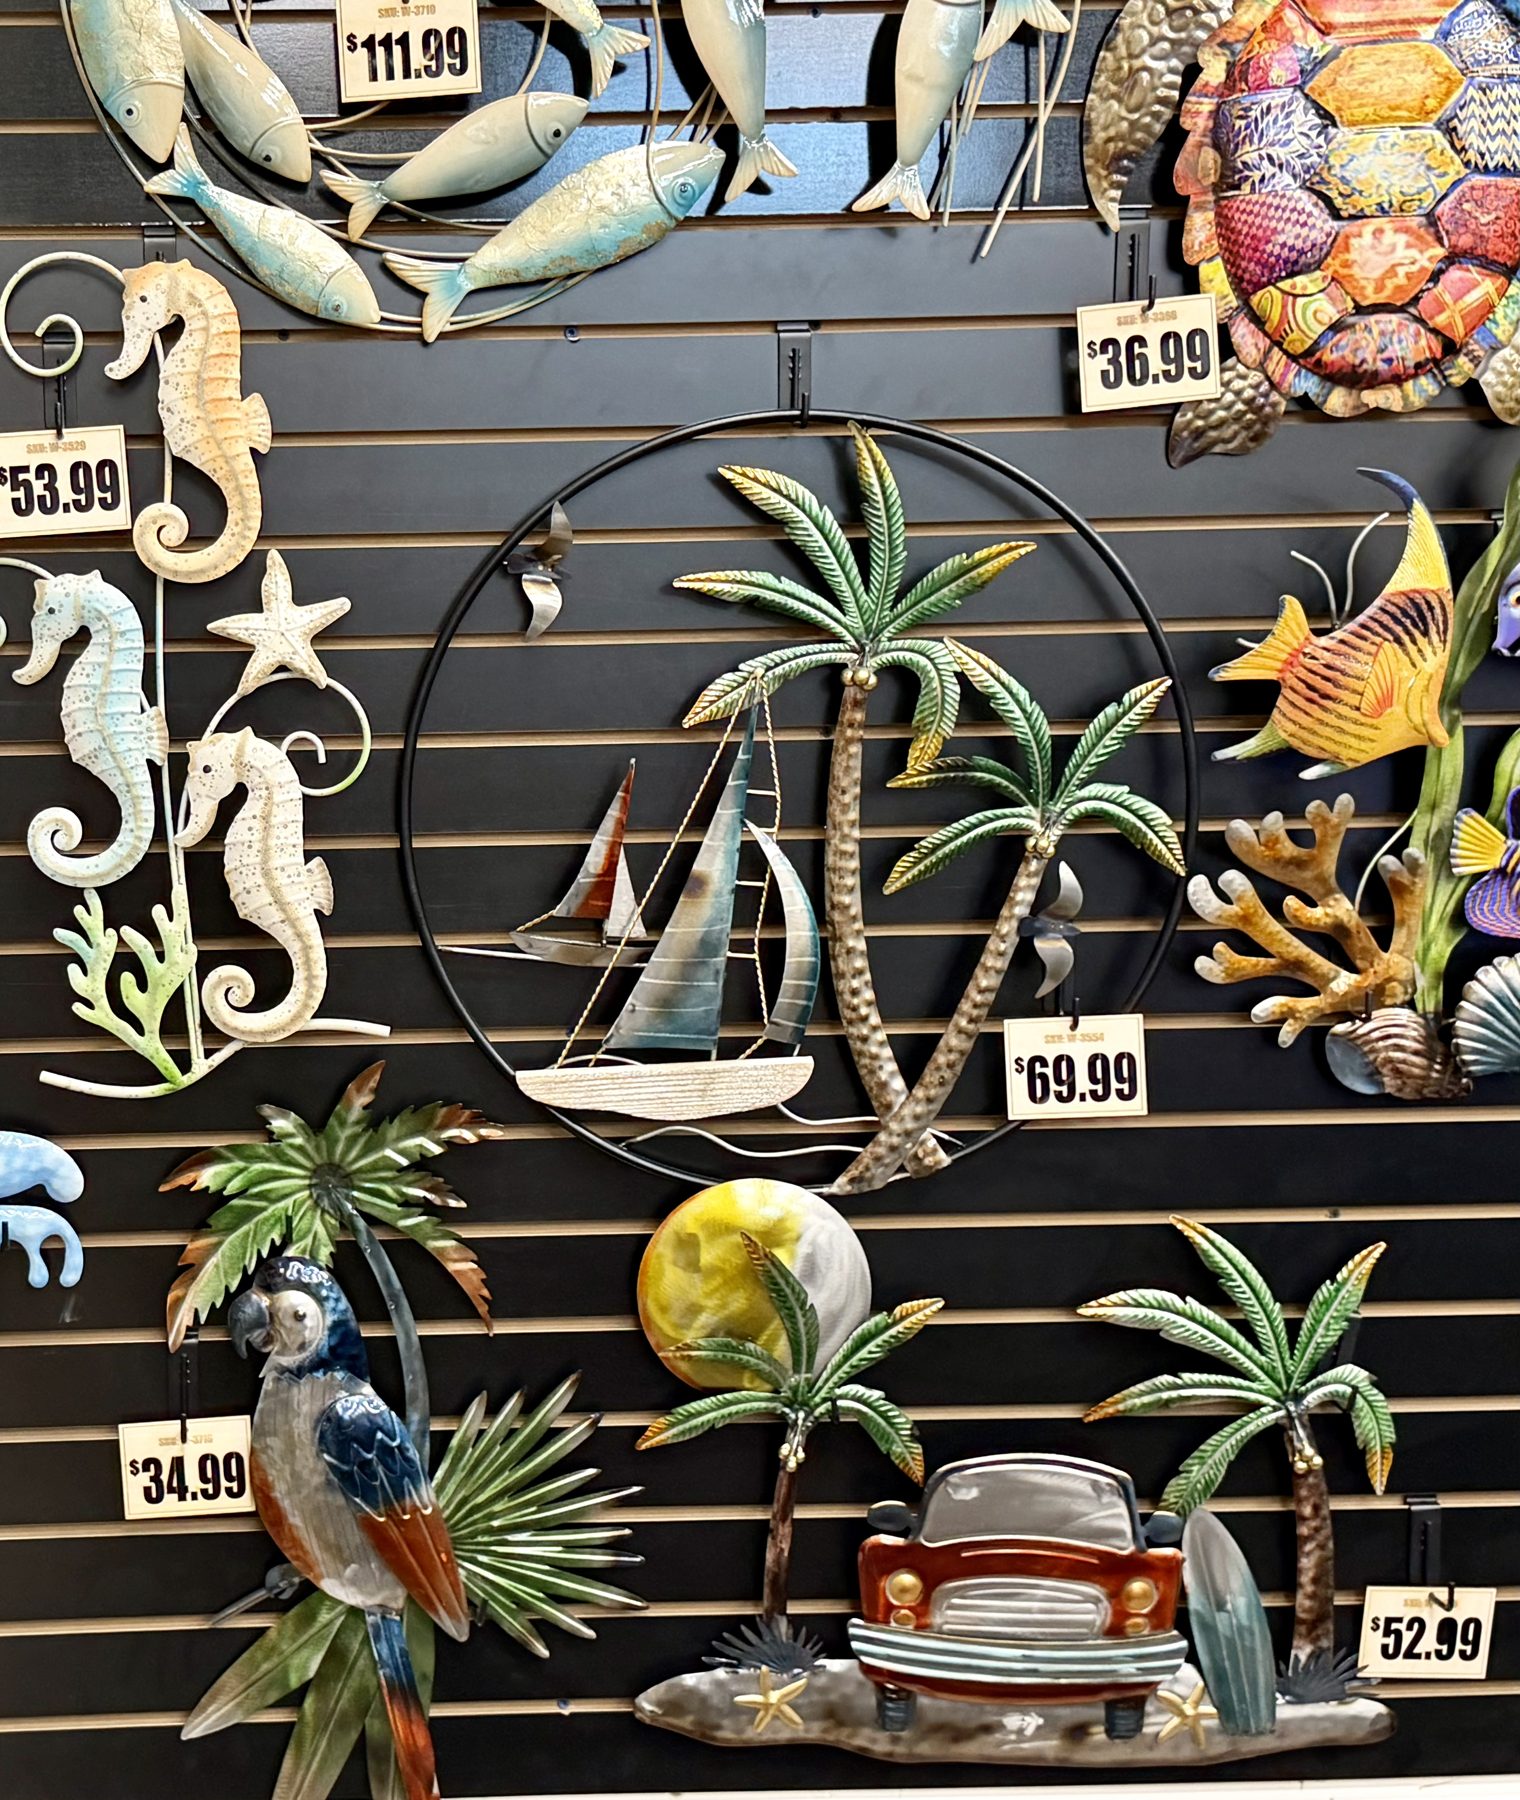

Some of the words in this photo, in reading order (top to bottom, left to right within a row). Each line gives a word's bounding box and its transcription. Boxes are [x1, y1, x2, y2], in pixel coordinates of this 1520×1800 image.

[401, 4, 436, 17] W-3710
[346, 26, 469, 82] $111.99
[1087, 328, 1211, 390] $36.99
[0, 459, 121, 517] $53.99
[1014, 1052, 1138, 1105] $69.99
[129, 1451, 246, 1505] $34.99
[1371, 1616, 1482, 1662] $52.99
